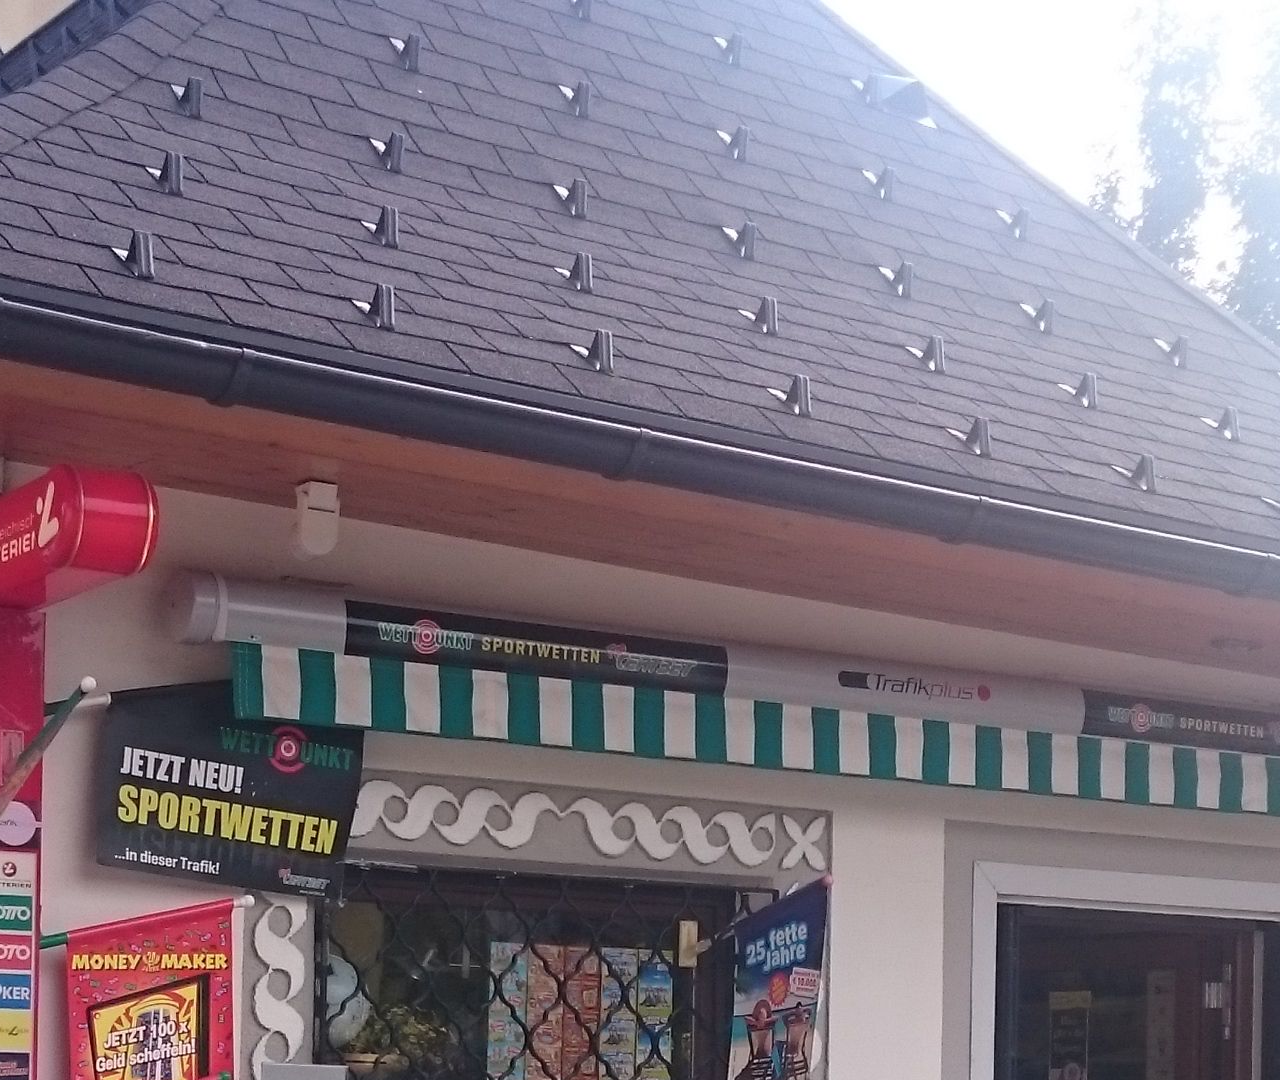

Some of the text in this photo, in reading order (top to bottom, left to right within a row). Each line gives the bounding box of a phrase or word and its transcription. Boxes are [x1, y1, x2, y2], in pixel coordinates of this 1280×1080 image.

[481, 637, 601, 664] SPORTWETTEN
[874, 673, 974, 700] Trafikplus
[1179, 717, 1264, 739] SPORTWETTEN
[120, 746, 245, 794] JETZT NEU!
[117, 783, 339, 855] SPORTWETTEN
[140, 849, 179, 868] dieser
[180, 856, 220, 875] Trafik!
[745, 921, 808, 966] 25 fette
[763, 941, 806, 973] Jahre
[71, 953, 142, 971] MONEY
[160, 953, 228, 970] MAKER
[104, 1020, 189, 1049] JETZT 100 x
[95, 1037, 196, 1073] Geld scheffeln!
